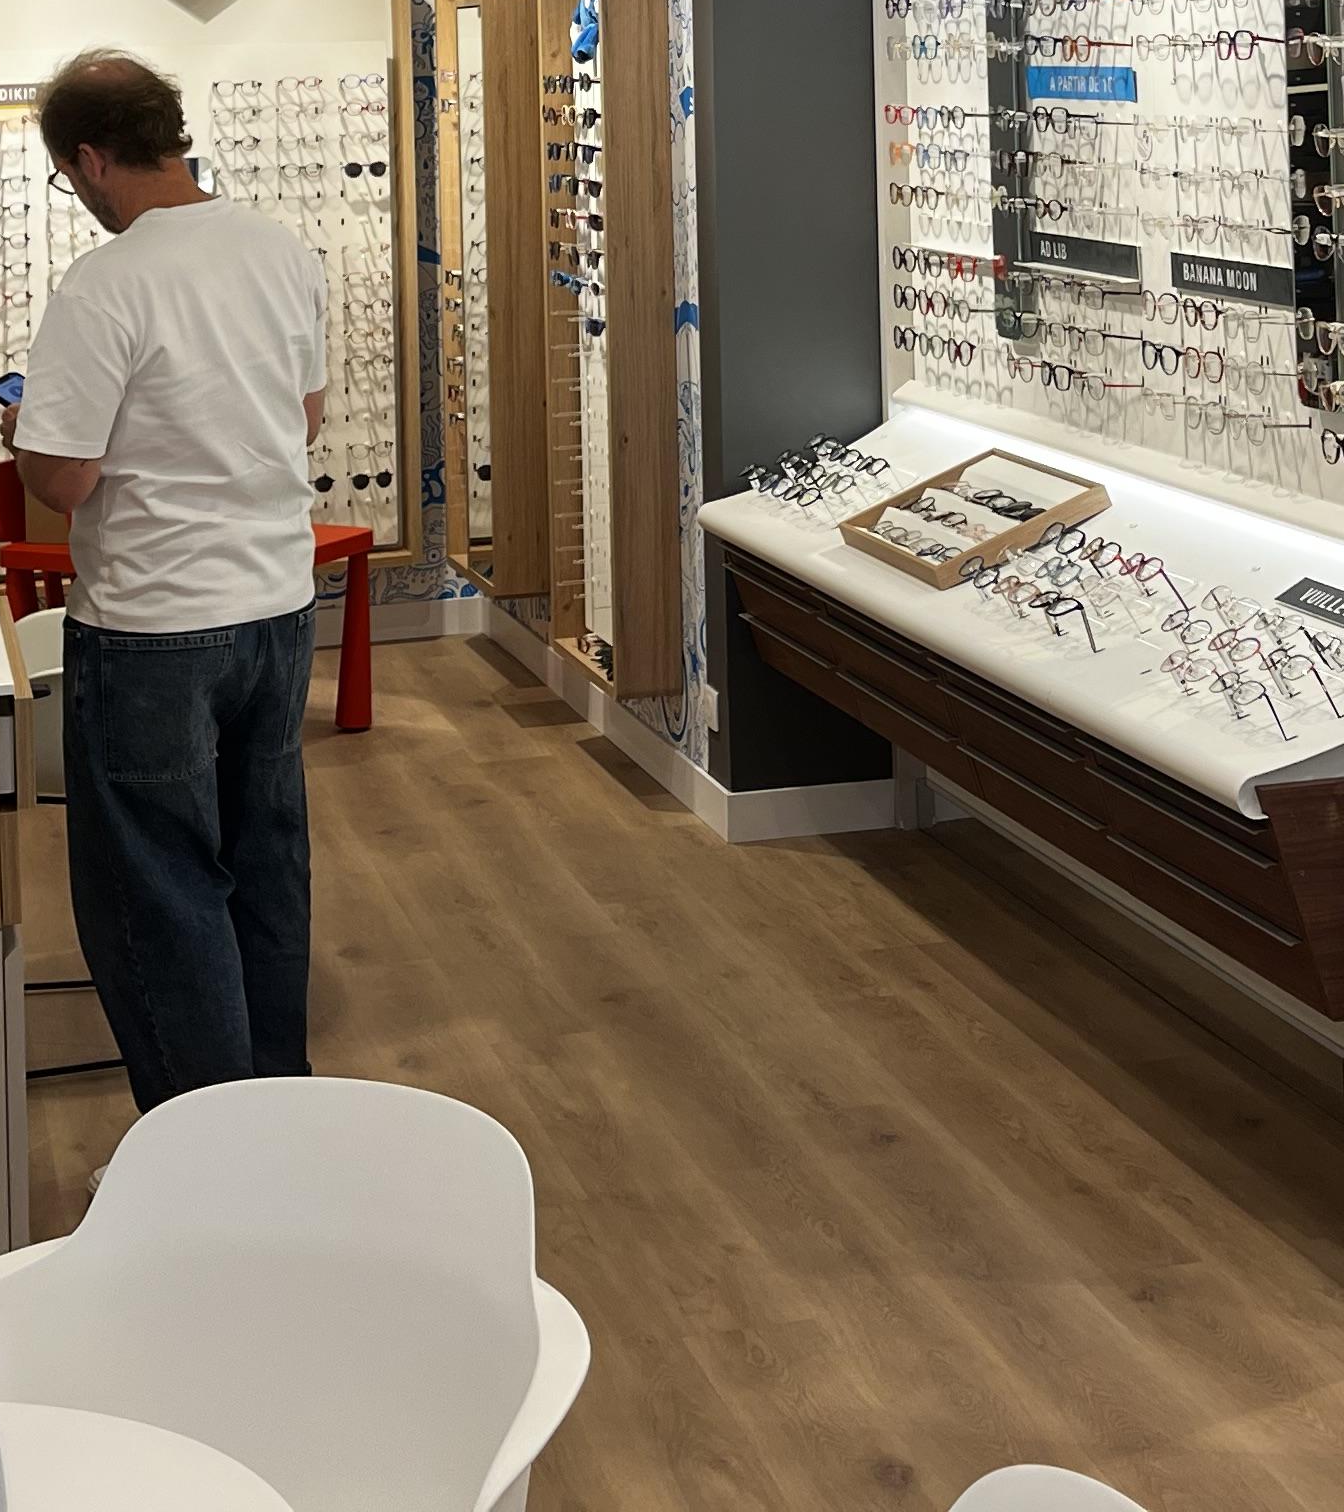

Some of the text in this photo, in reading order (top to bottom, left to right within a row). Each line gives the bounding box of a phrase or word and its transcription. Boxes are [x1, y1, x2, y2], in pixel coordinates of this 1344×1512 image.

[1057, 75, 1086, 93] PARTIR
[1088, 74, 1100, 92] DE
[1040, 239, 1067, 260] AD LIB
[1183, 262, 1257, 292] BANANA MOON
